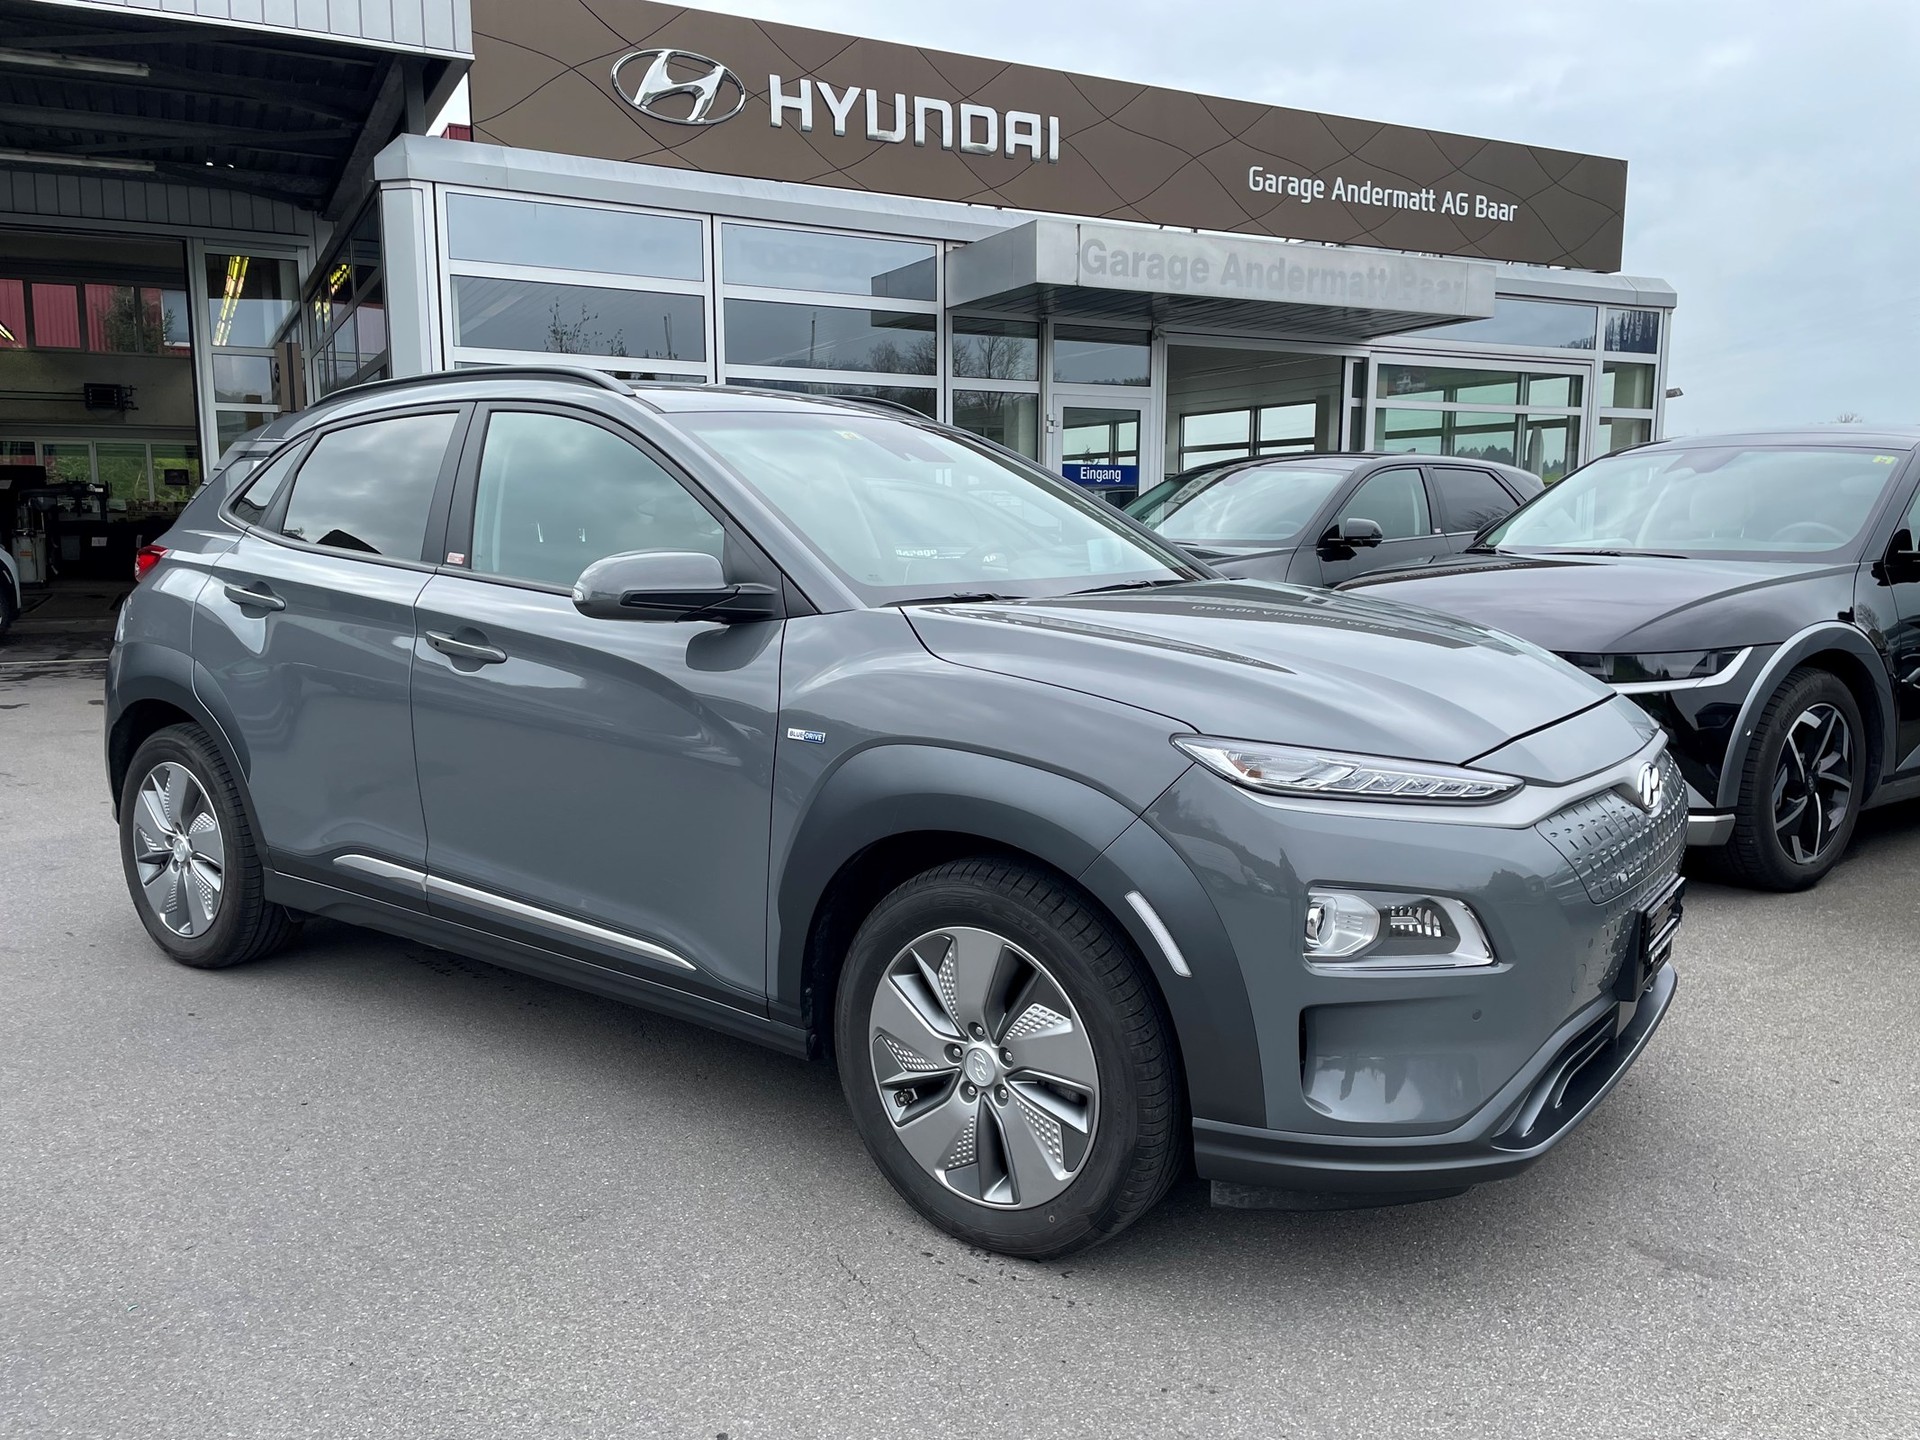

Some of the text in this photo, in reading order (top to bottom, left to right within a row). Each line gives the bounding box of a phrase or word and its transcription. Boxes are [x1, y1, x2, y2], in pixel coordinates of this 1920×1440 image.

[769, 74, 1060, 164] HYUNDAI
[1249, 166, 1518, 222] Garage Andermatt AG Baar
[1081, 239, 1210, 290] Garage
[1220, 252, 1388, 297] Andermatt
[1080, 466, 1121, 482] Eingang
